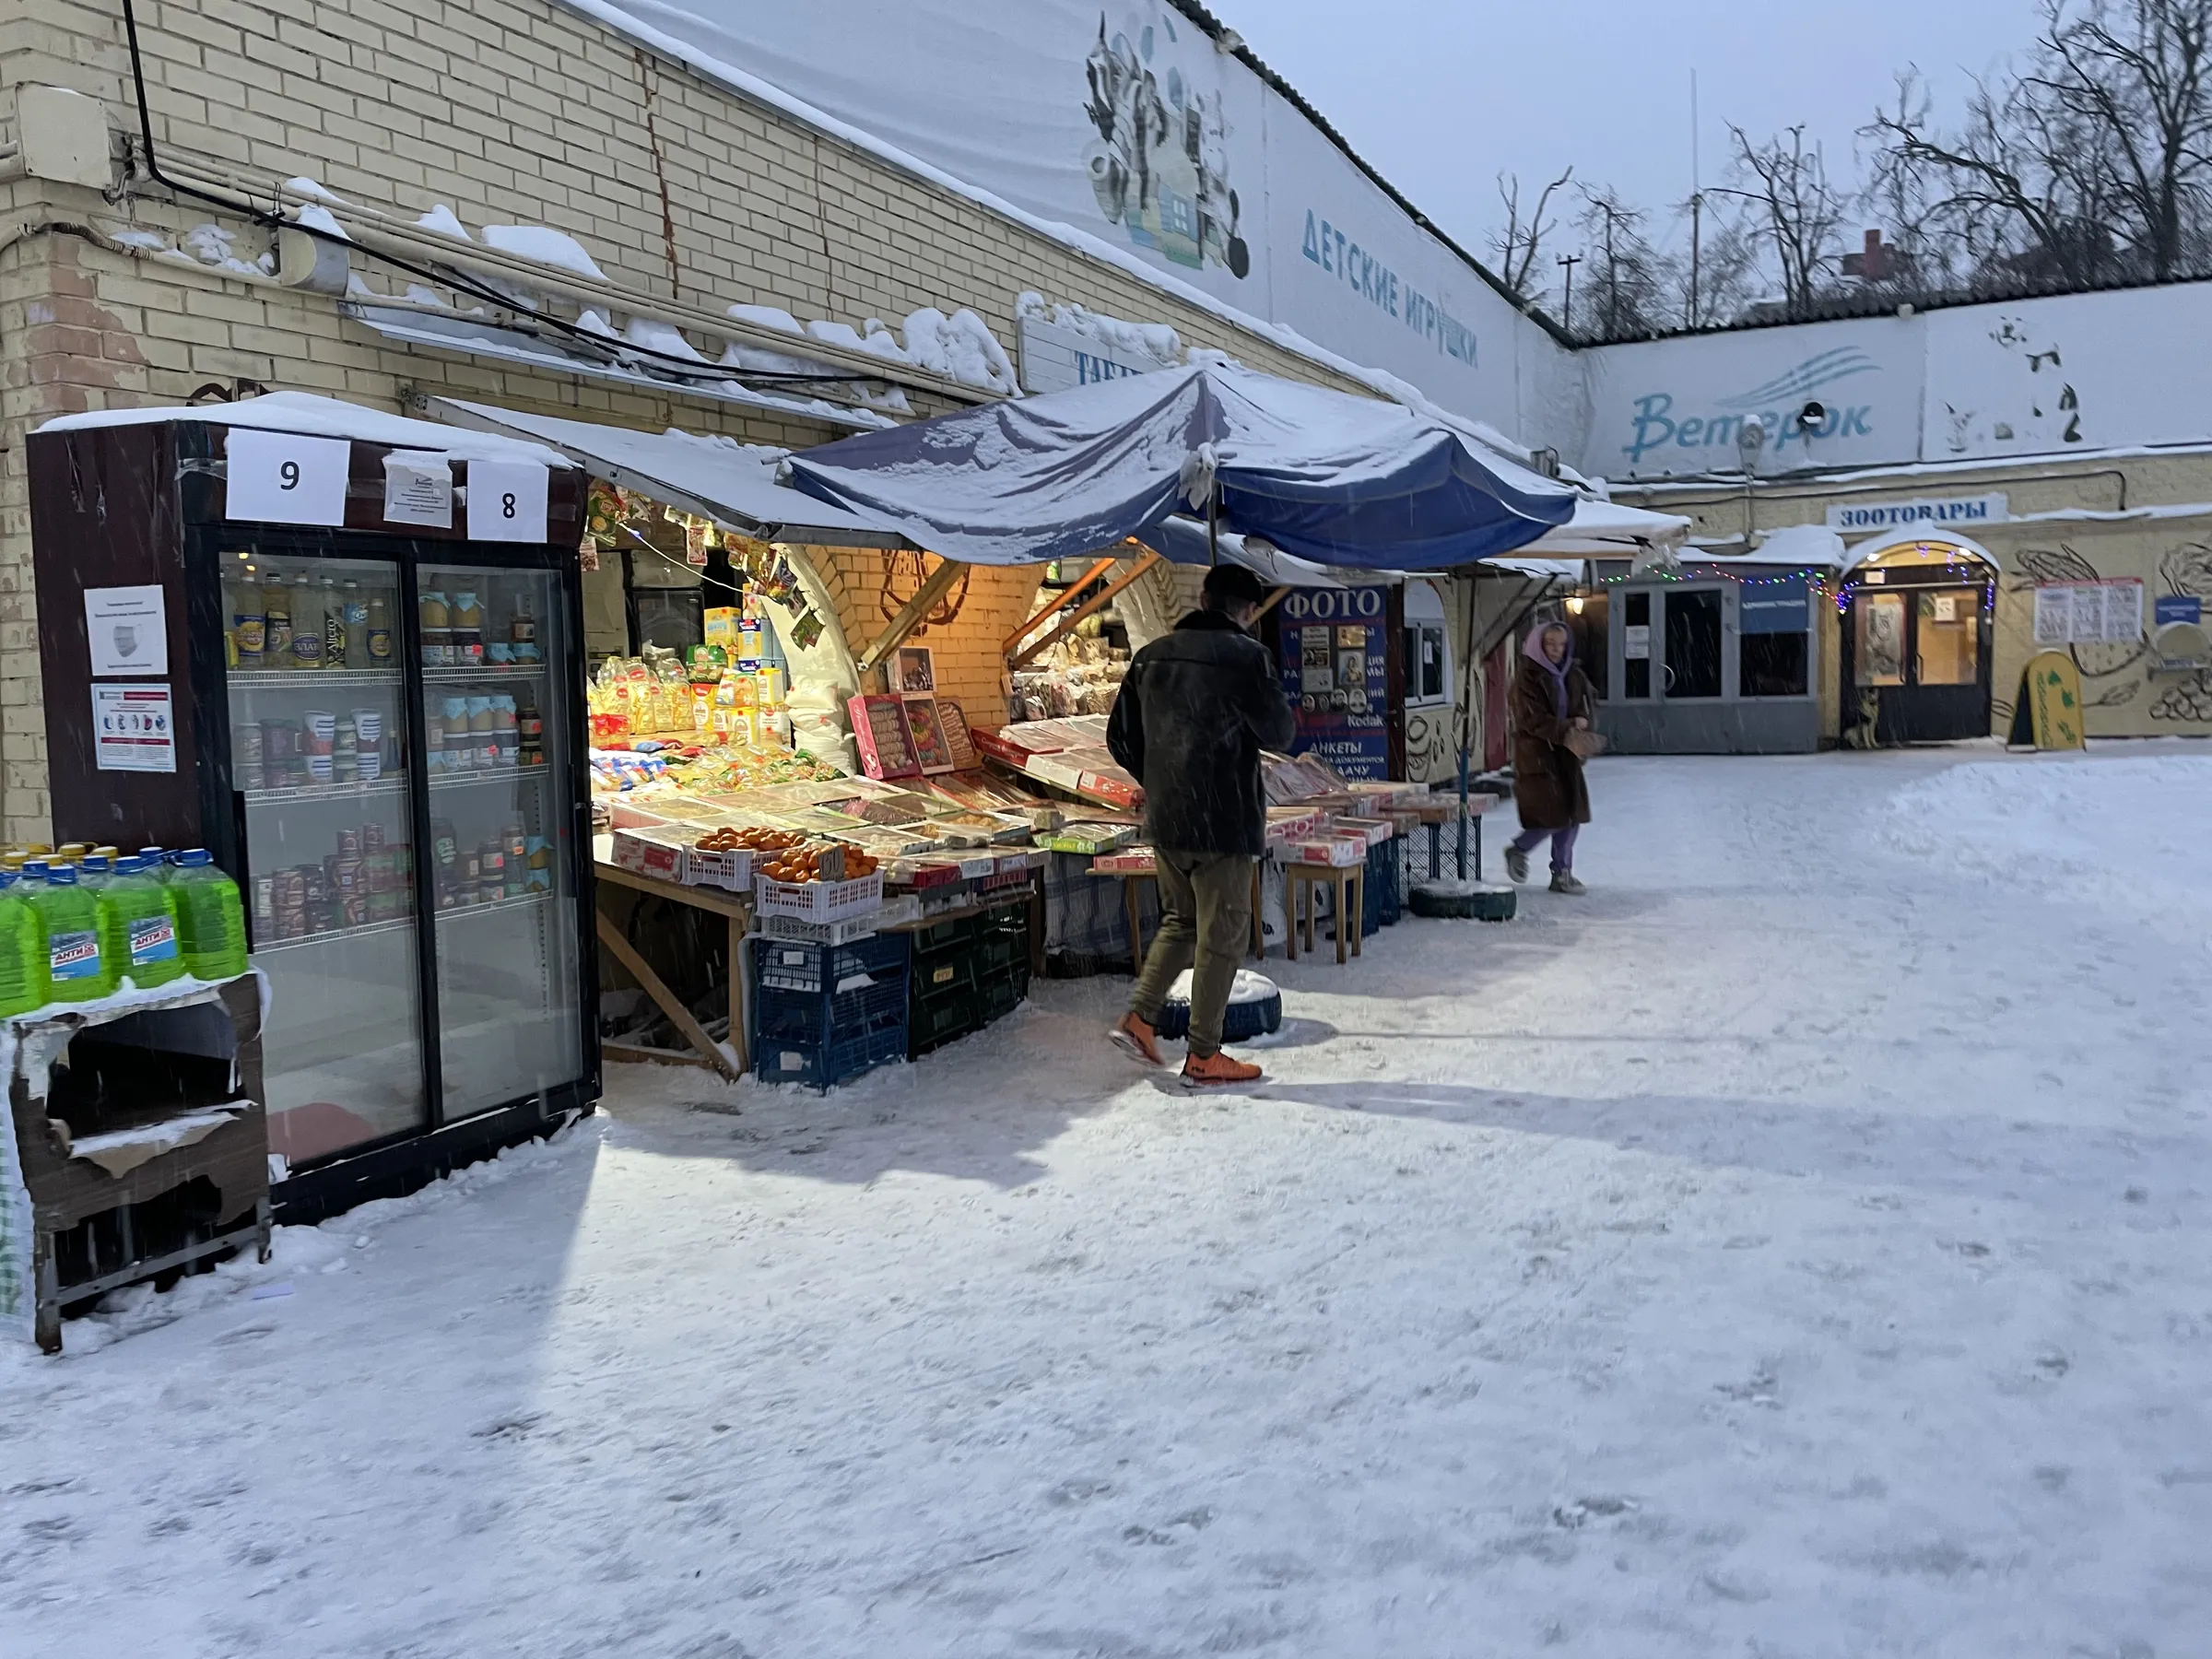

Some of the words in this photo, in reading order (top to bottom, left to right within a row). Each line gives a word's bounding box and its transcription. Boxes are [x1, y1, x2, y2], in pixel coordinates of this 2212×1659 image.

[1302, 208, 1399, 320] ДЕТСКИЕ
[1405, 282, 1478, 371] ИГРУШКИ
[280, 461, 300, 490] 9
[502, 492, 515, 519] 8
[1841, 501, 1987, 527] ЗООТОВАРЫ
[1284, 589, 1381, 619] ФОТО
[1347, 714, 1384, 728] Kodak
[1309, 741, 1362, 755] АНКЕТЫ
[135, 931, 160, 947] АНТИ
[55, 947, 84, 962] АНТИ
